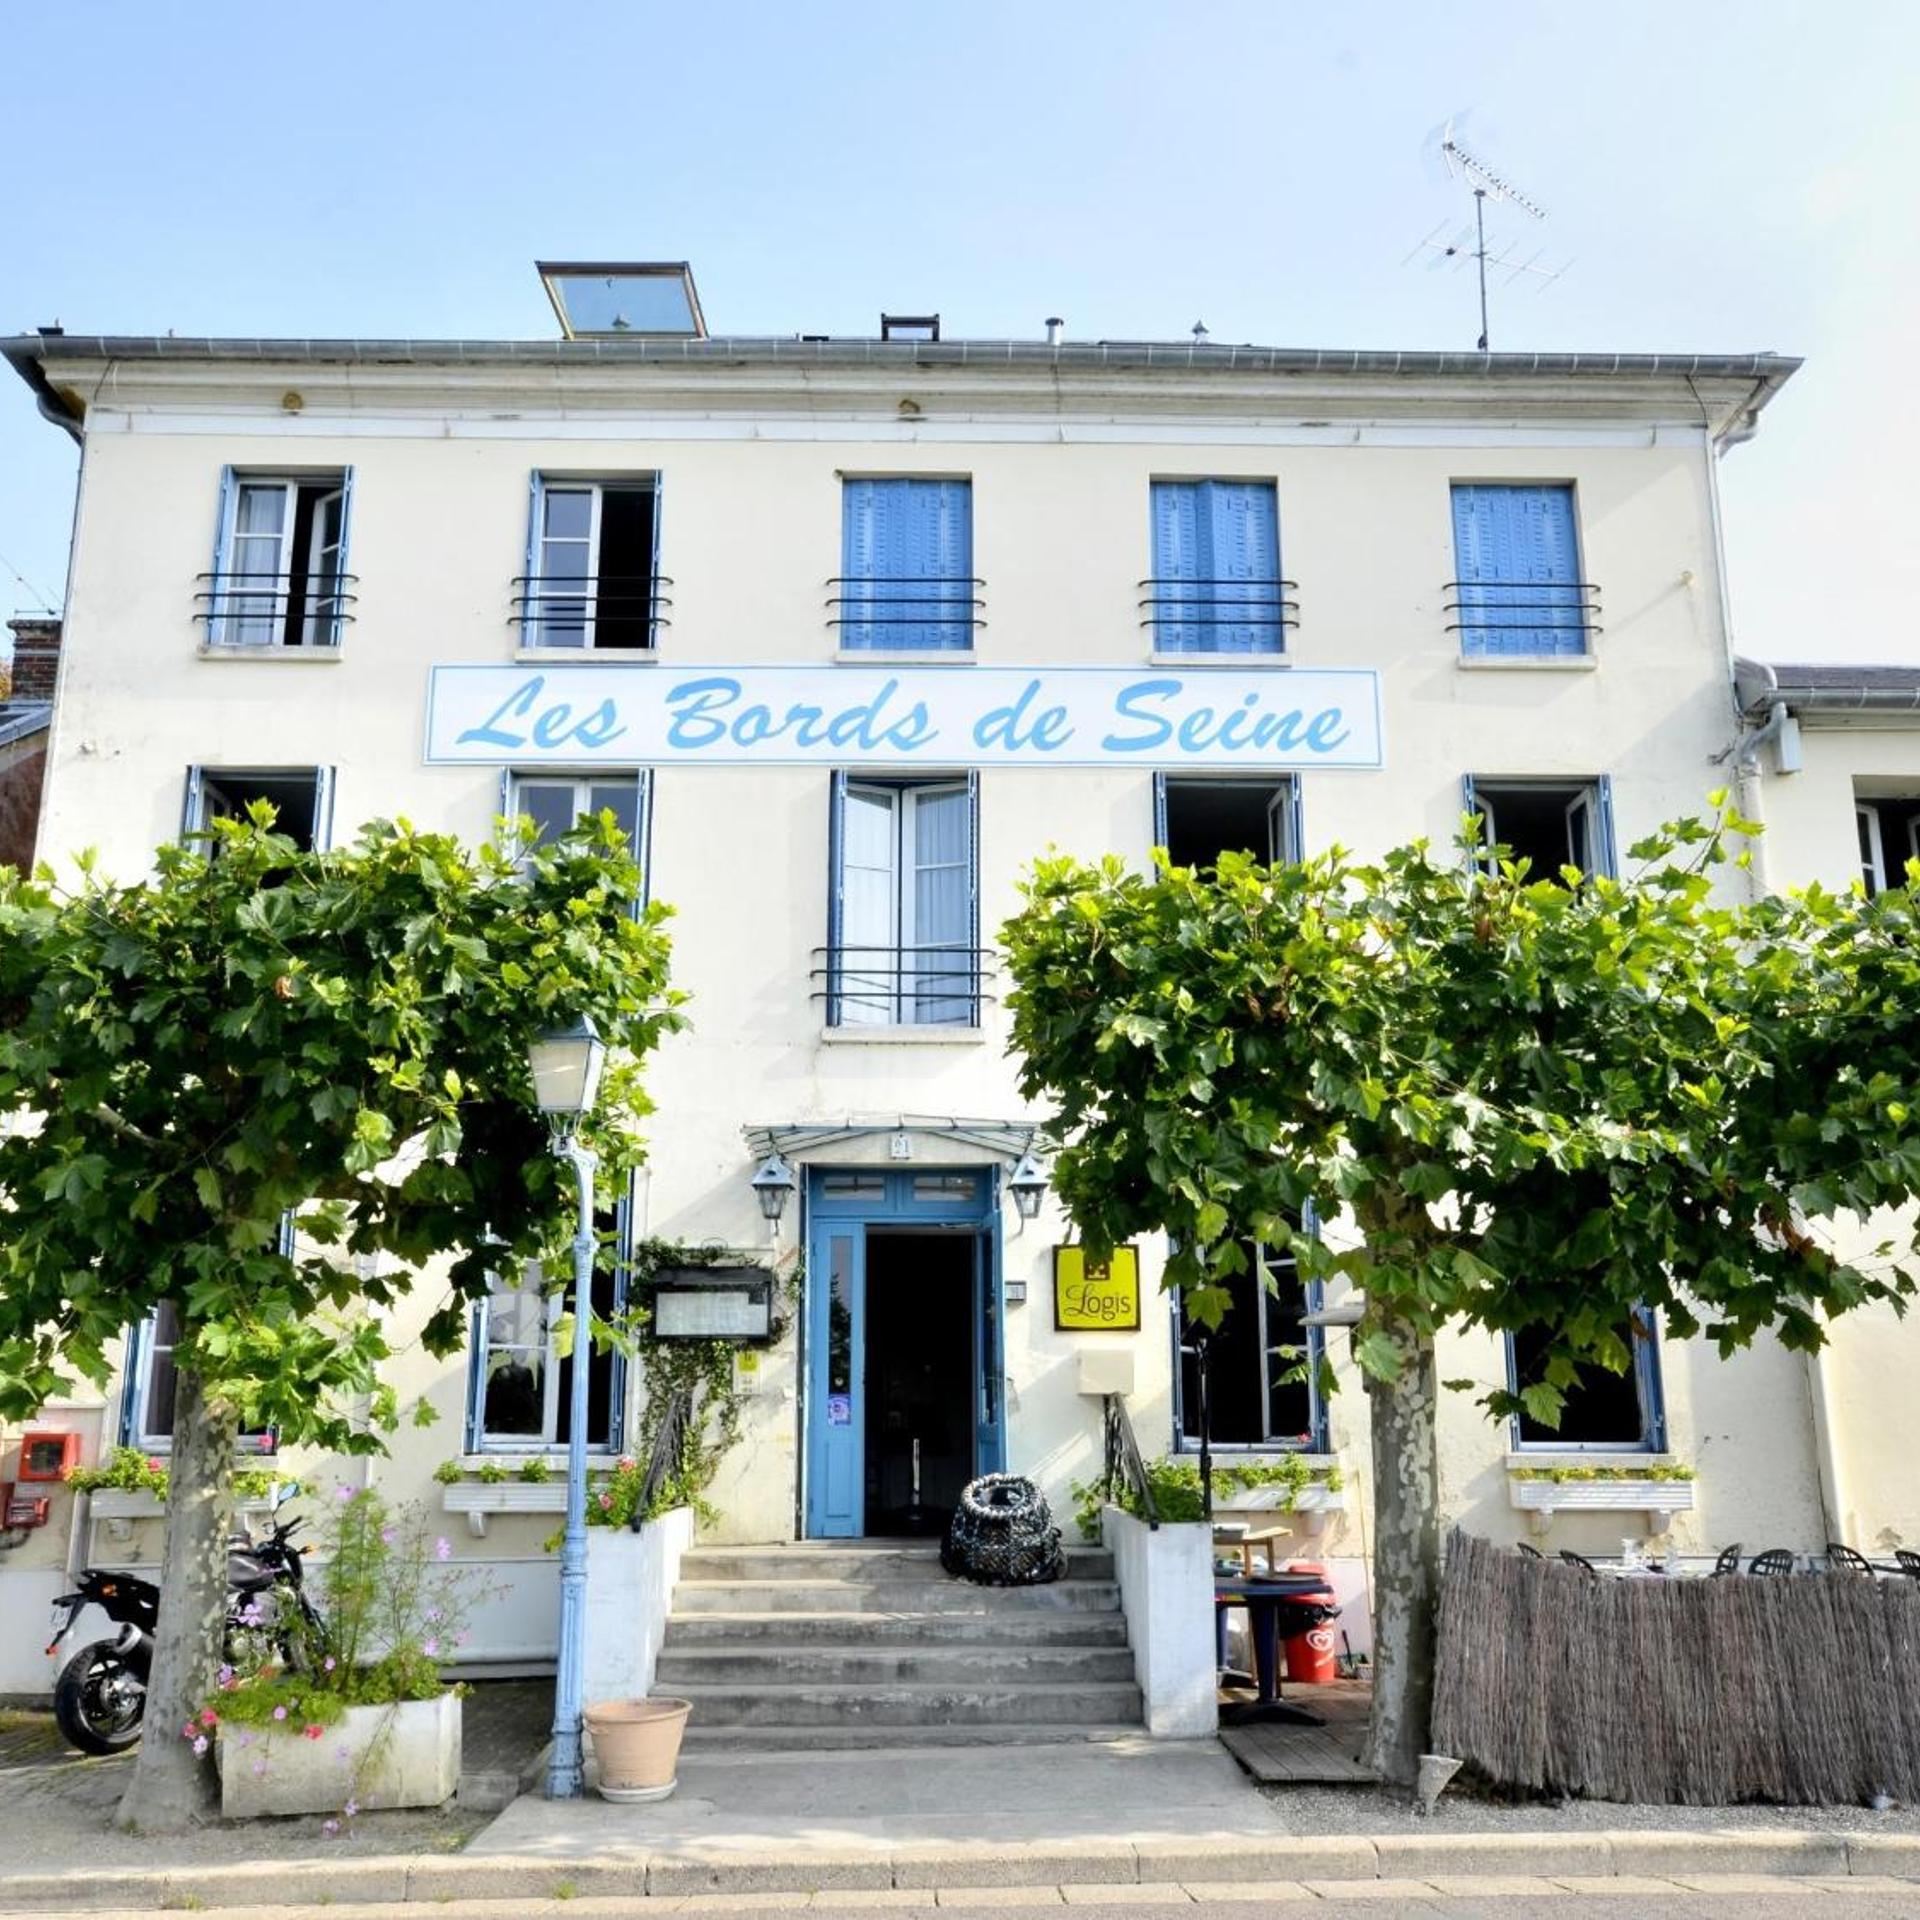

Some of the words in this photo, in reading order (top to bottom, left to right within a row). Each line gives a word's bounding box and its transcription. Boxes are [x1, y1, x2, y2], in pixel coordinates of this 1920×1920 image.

[456, 676, 627, 748] Les
[666, 677, 938, 749] Bords
[973, 680, 1073, 752] de
[1102, 679, 1350, 753] Seine
[1064, 1283, 1131, 1321] Logis
